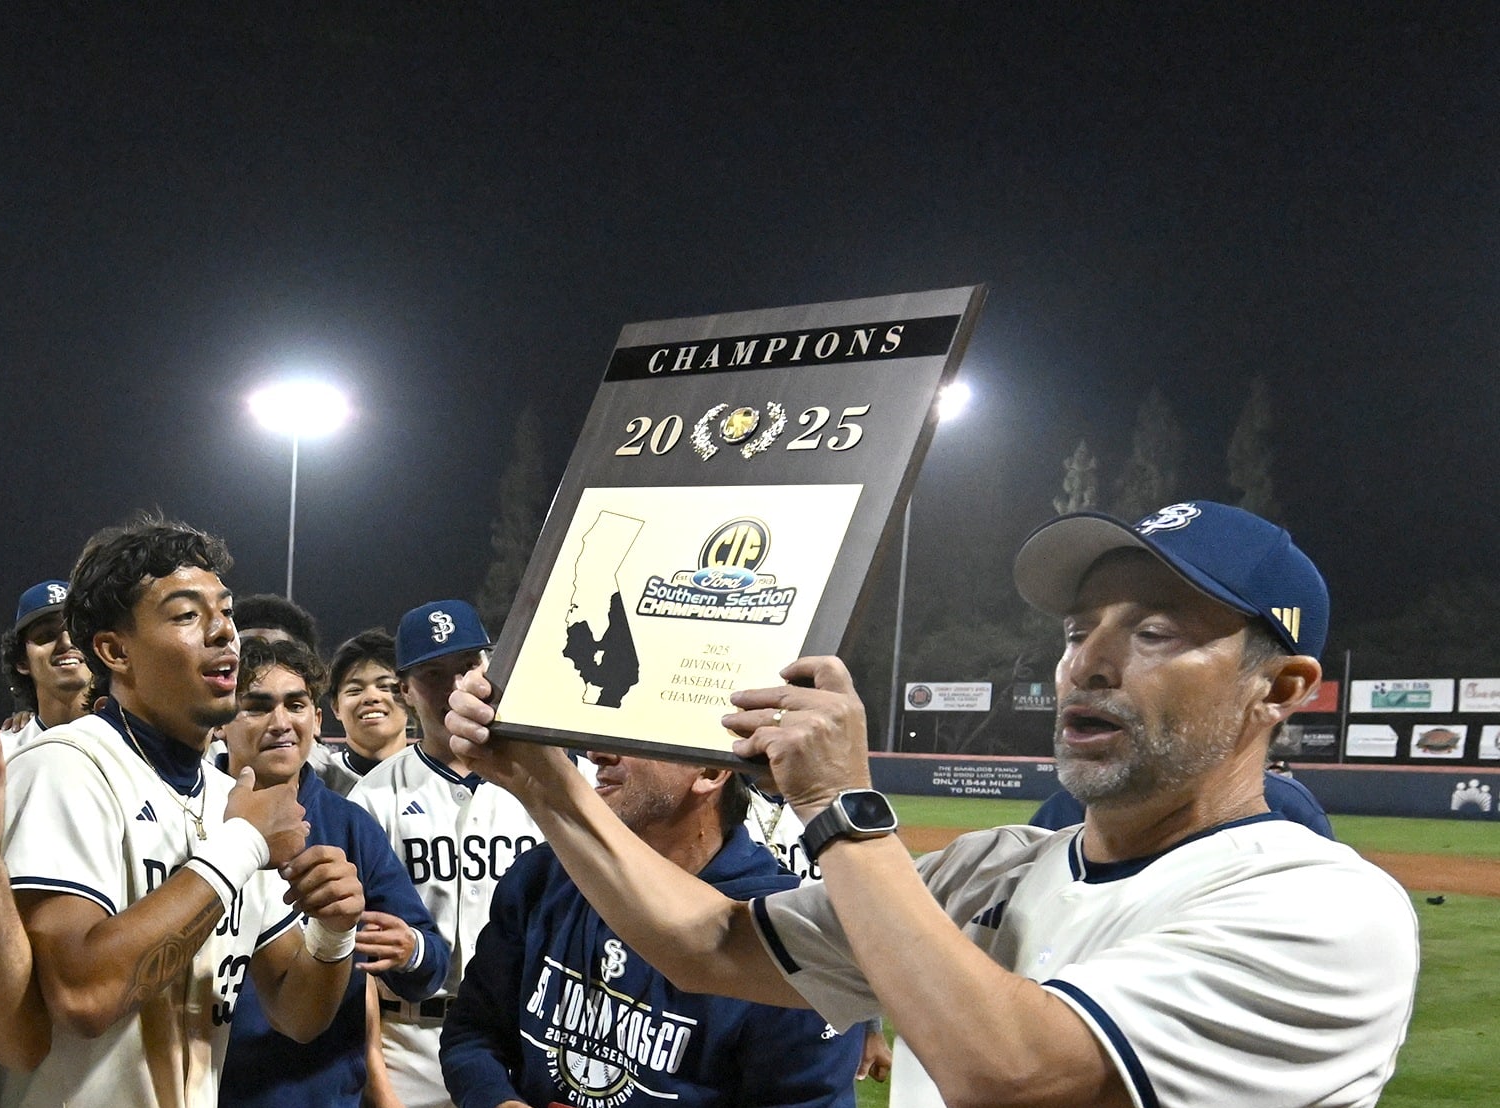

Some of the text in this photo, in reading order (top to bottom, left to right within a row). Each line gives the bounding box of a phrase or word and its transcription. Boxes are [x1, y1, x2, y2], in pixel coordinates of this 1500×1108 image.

[648, 325, 904, 374] CHAMPIONS
[615, 403, 871, 456] 20 25
[707, 525, 762, 568] CIF
[646, 578, 792, 607] Southern Section
[701, 571, 745, 589] Ford
[639, 597, 789, 623] CHAMPIONSHIPS
[703, 644, 730, 656] 2025
[680, 658, 733, 672] DIVISION
[671, 673, 736, 690] BASEBALL
[660, 690, 734, 707] CHAMPION
[965, 787, 1001, 795] OMAHA
[212, 955, 251, 1026] 33
[545, 1027, 577, 1047] 2024
[616, 1003, 692, 1074] BOSCO
[546, 1050, 567, 1091] STATE
